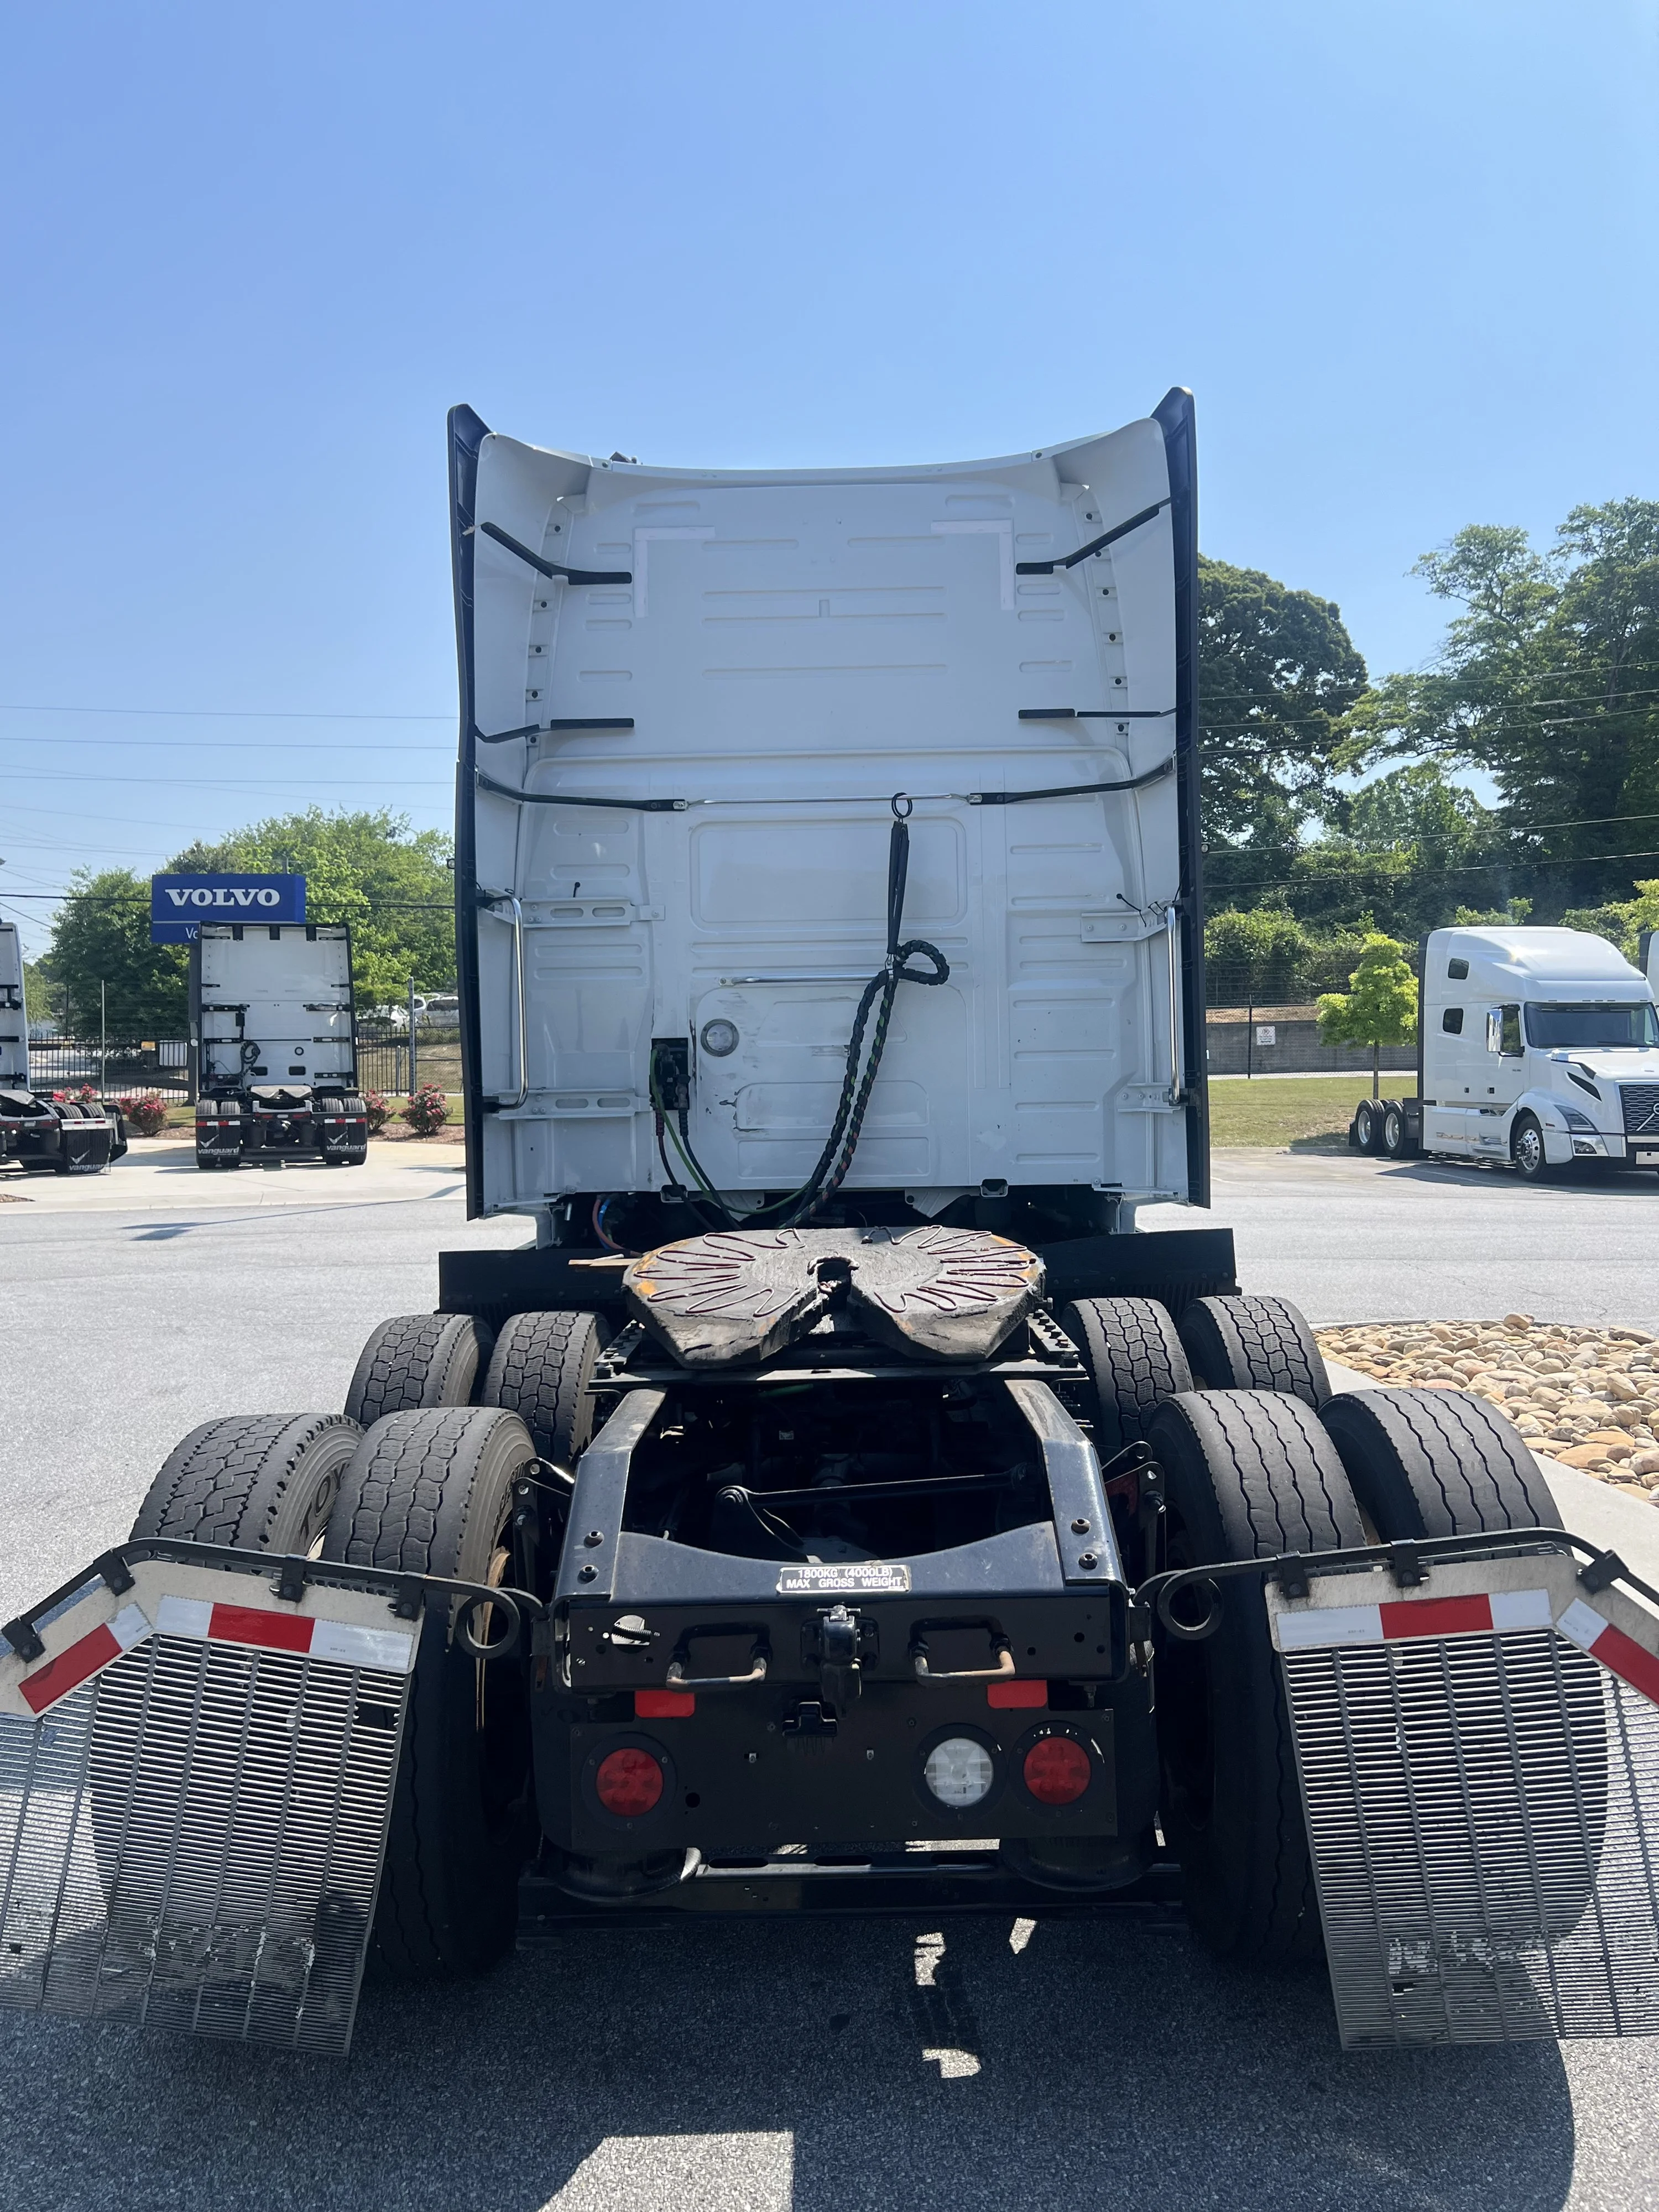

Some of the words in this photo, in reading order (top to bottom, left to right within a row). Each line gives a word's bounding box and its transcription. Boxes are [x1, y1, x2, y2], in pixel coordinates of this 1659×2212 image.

[165, 888, 280, 906] VOLVO
[197, 1146, 239, 1155] vanguard
[326, 1143, 366, 1152] vanguard
[298, 1459, 347, 1543] TOY
[798, 1568, 838, 1579] 1800KG
[844, 1567, 893, 1578] (4000LB)
[786, 1578, 811, 1589] MAX
[818, 1577, 855, 1588] GROSS
[861, 1576, 903, 1587] WEIGHT
